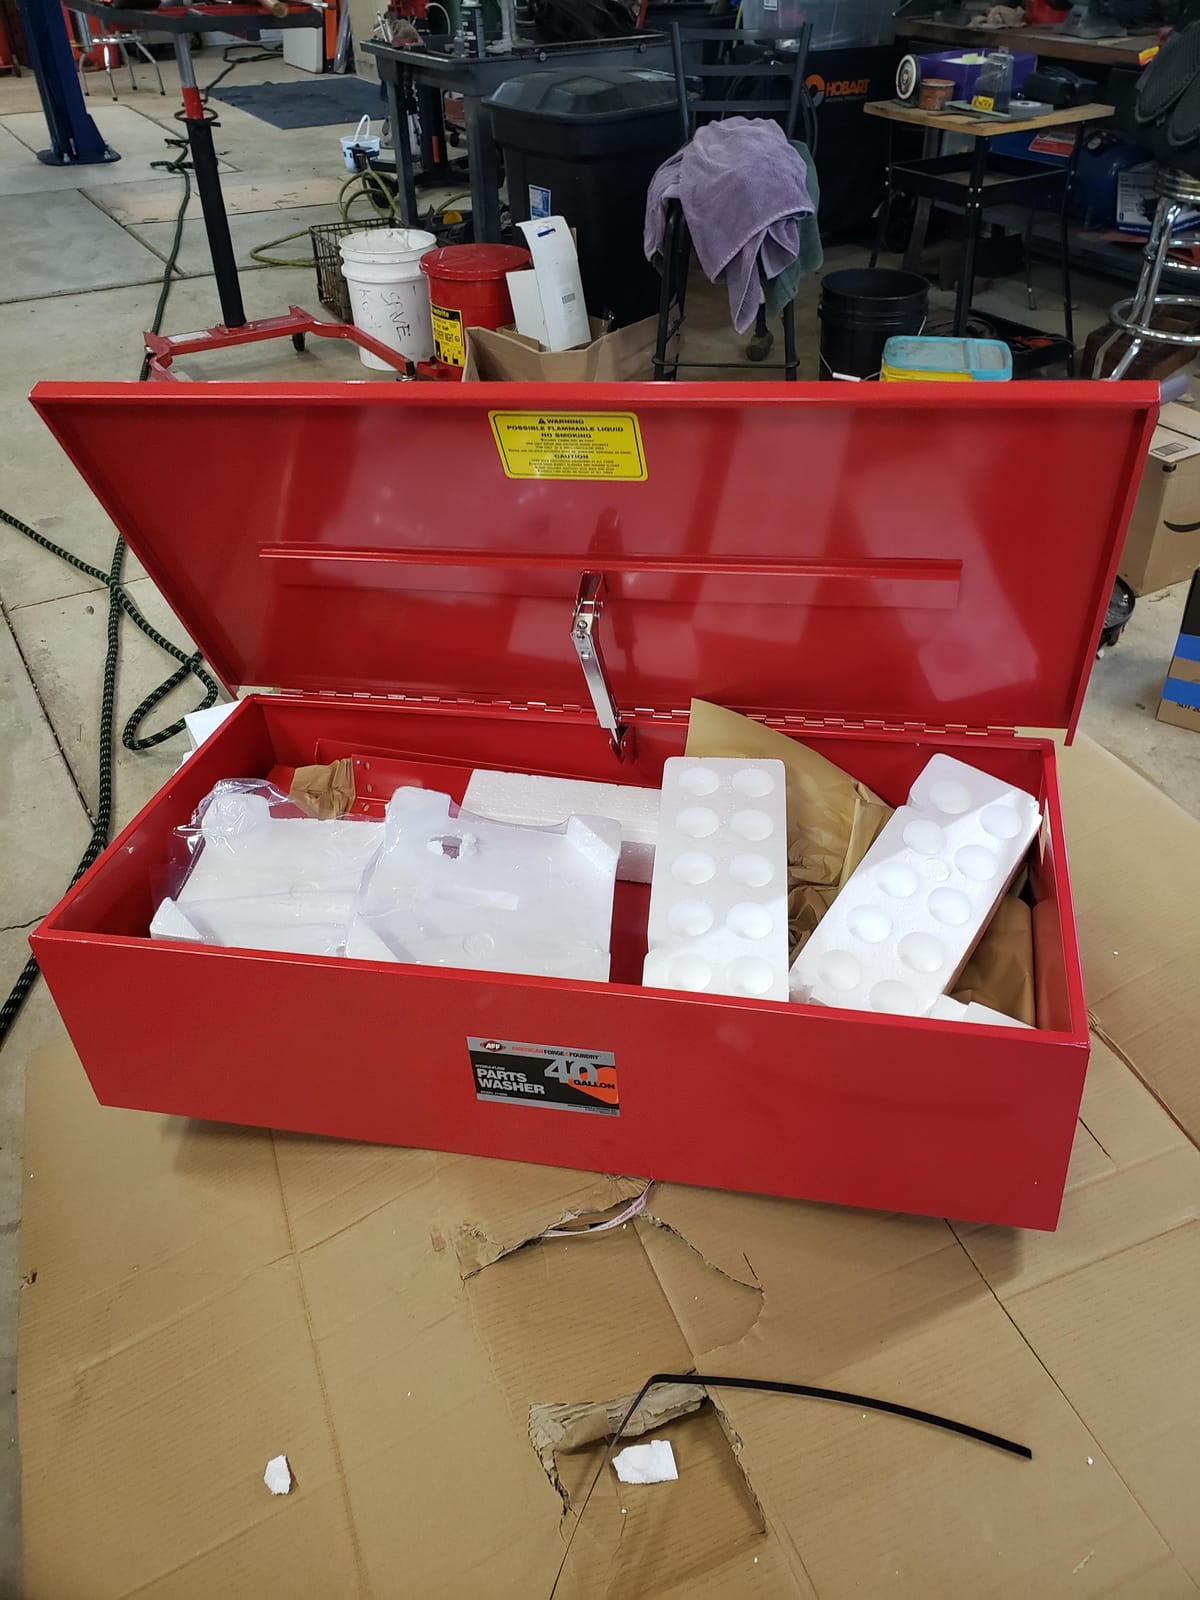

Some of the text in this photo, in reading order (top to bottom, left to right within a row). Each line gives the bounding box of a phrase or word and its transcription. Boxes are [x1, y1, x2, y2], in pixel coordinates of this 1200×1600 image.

[826, 80, 869, 96] HOBART
[486, 1042, 500, 1050] AFF
[476, 1069, 527, 1083] PARTS
[544, 1058, 597, 1084] 40
[478, 1078, 546, 1095] WASHER
[573, 1079, 616, 1090] GALLON
